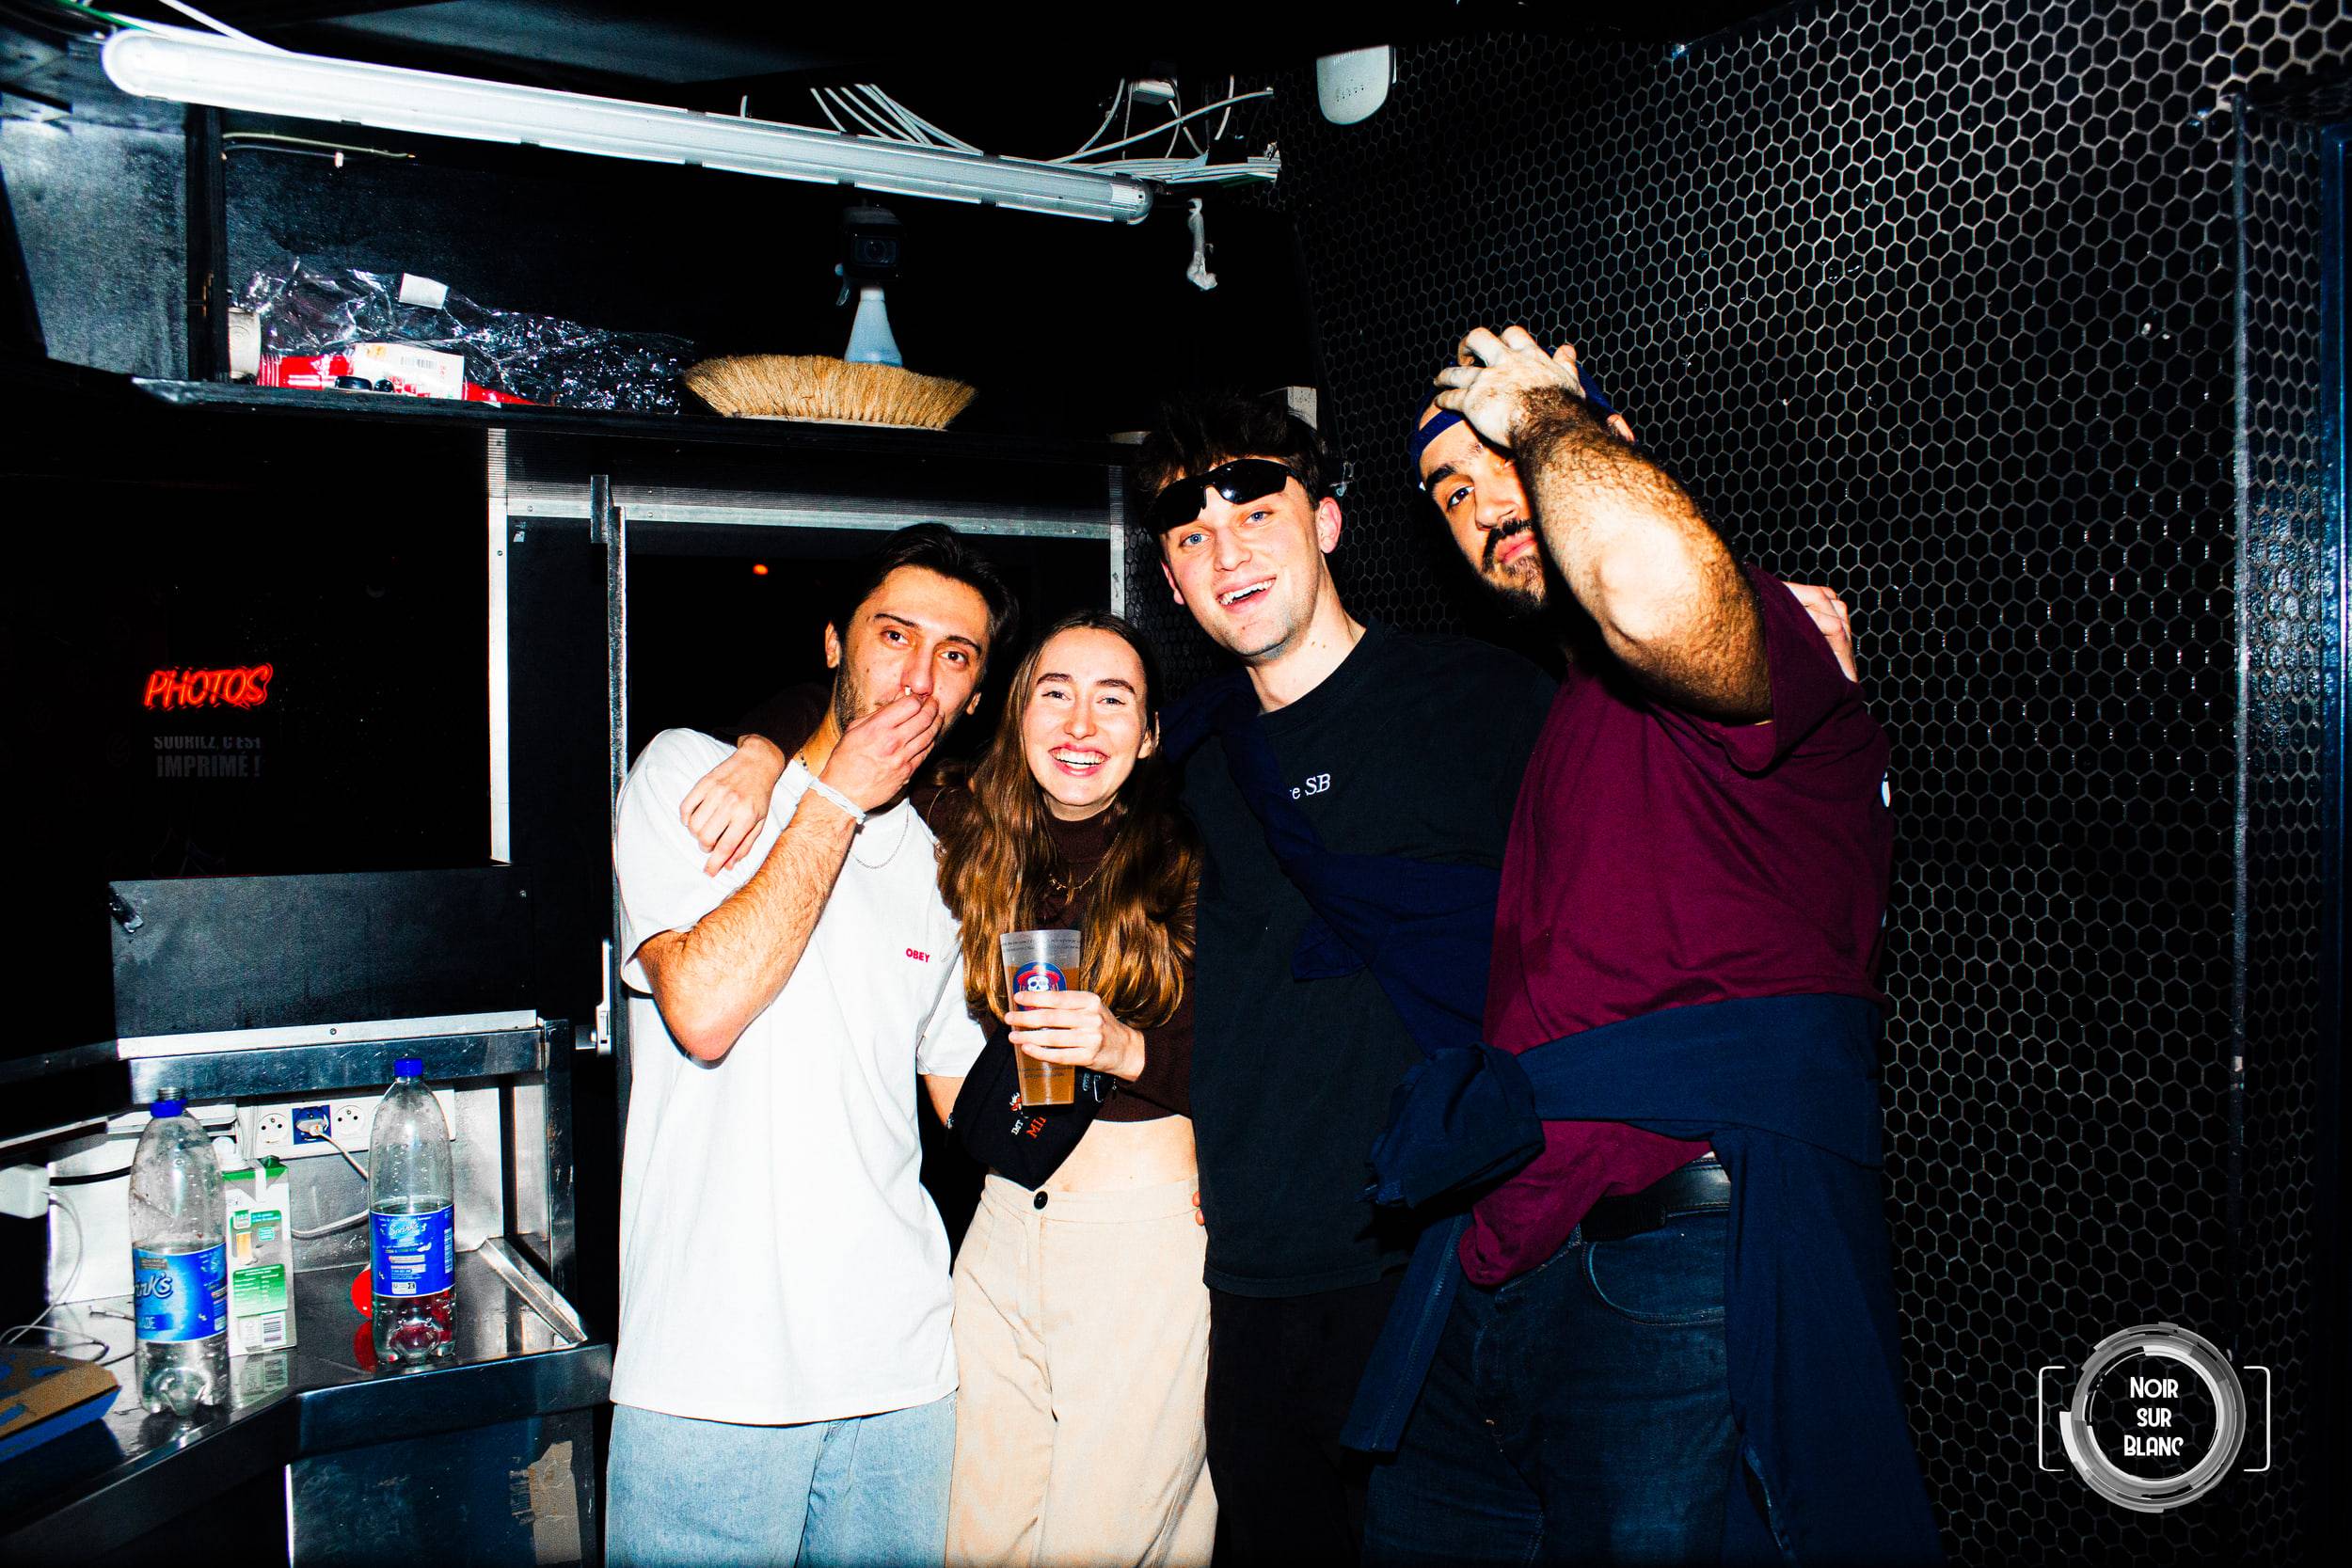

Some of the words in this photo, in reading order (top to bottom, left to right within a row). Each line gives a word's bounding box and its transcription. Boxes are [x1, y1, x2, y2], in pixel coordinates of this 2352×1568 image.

[145, 664, 273, 707] PHOTOS
[1305, 773, 1330, 796] SB
[906, 948, 930, 962] OBEY
